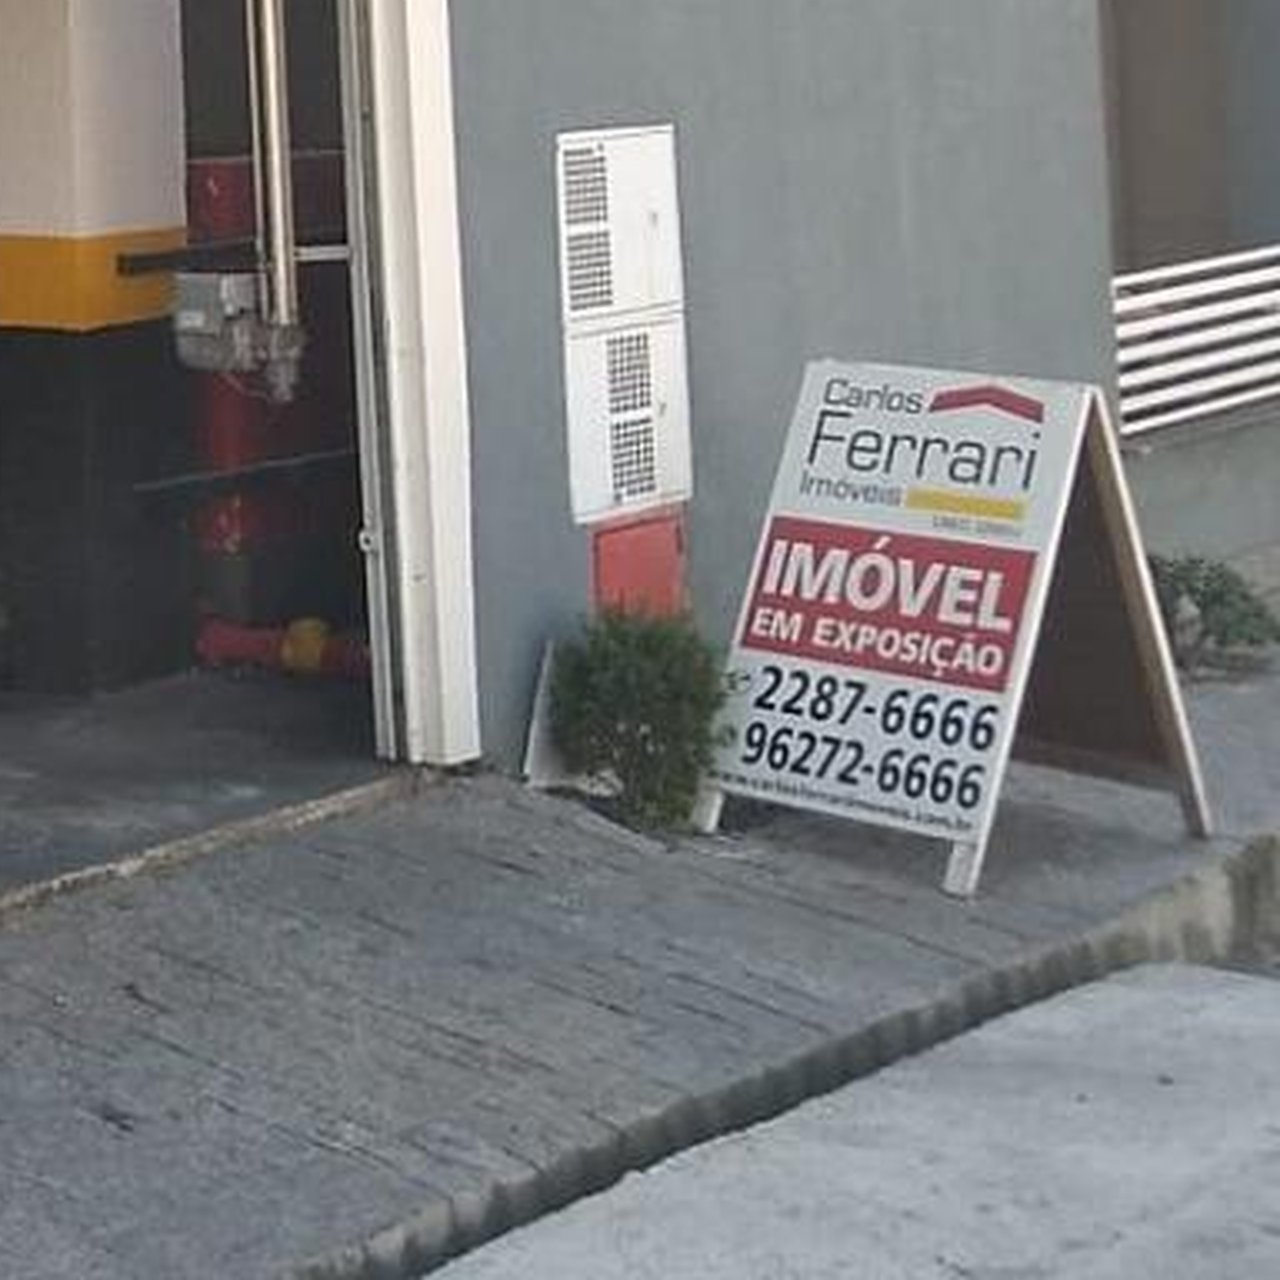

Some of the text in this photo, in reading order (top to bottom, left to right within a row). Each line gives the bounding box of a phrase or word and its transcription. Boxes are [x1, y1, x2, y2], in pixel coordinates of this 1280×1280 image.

[823, 377, 925, 414] Carlos
[807, 409, 1042, 490] Ferrari
[762, 535, 1013, 633] IMÓVEL
[749, 606, 1004, 677] EM EXPOSIÇÃO
[751, 665, 998, 751] 2287-6666
[742, 722, 983, 808] 96272-6666
